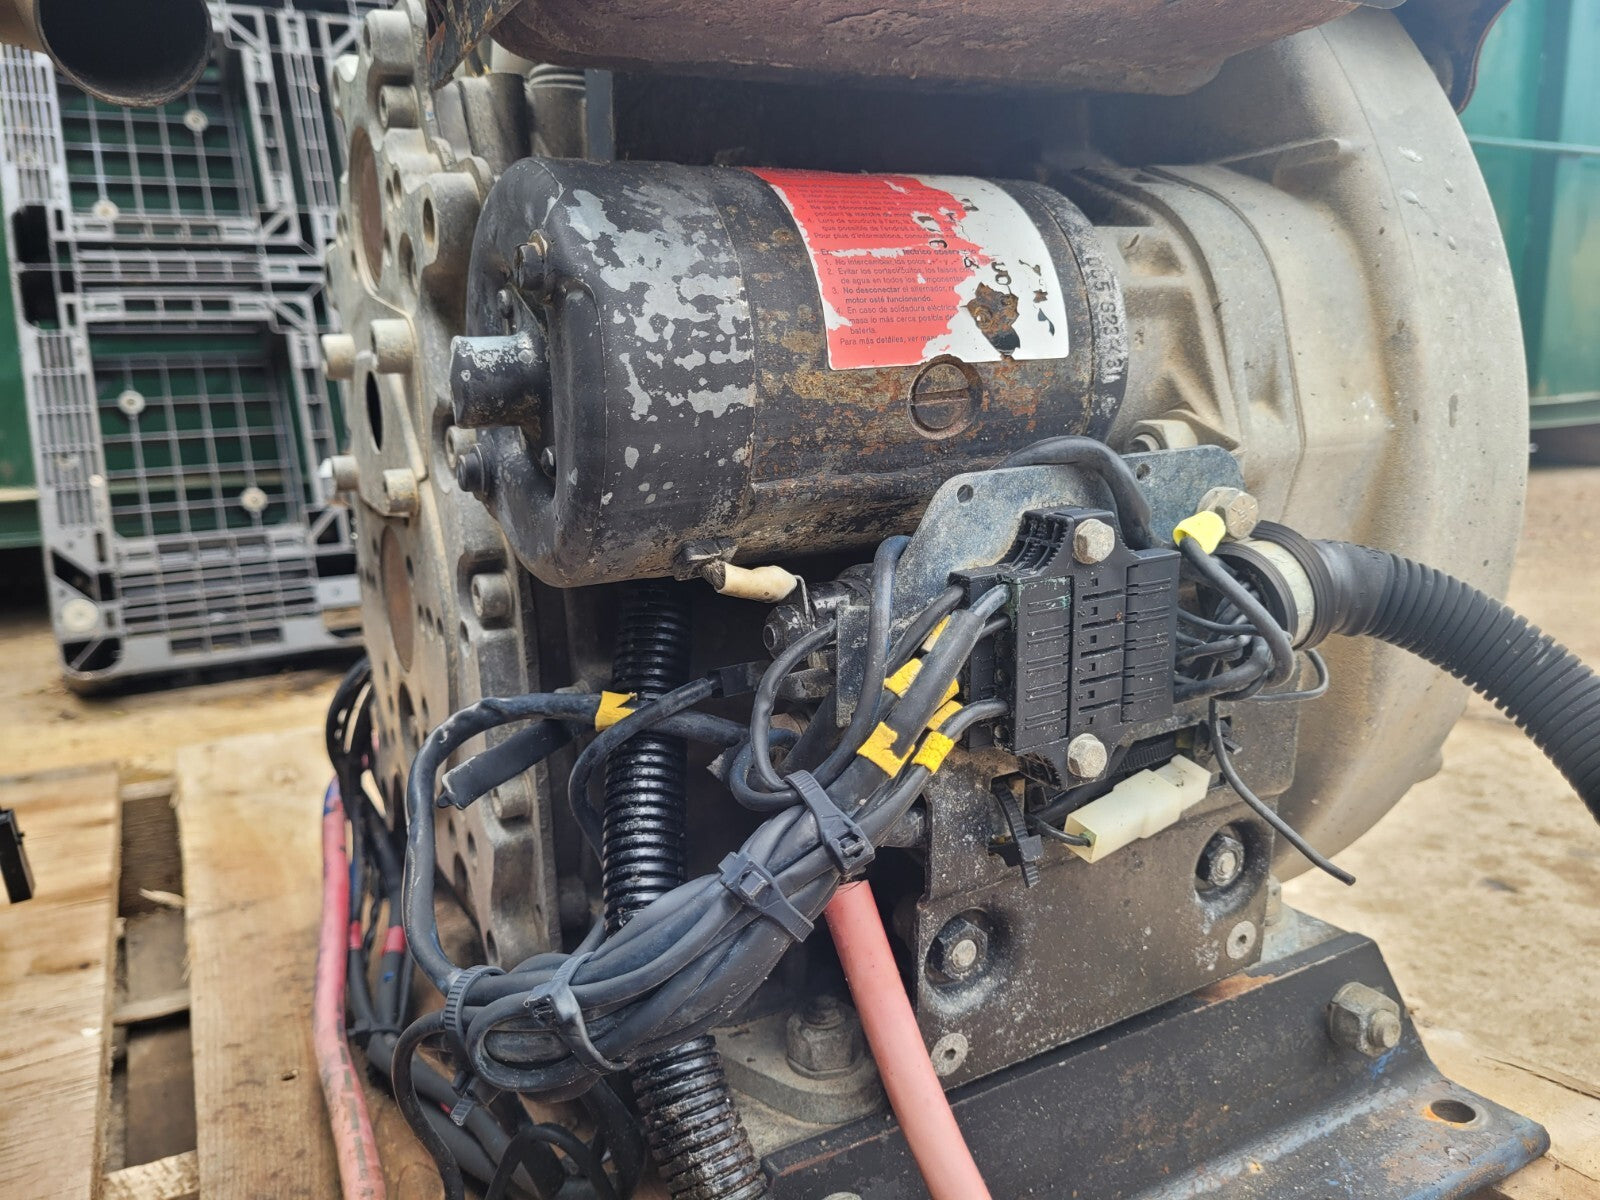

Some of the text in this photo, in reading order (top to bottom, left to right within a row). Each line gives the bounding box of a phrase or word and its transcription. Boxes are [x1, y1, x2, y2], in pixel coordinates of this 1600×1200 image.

[886, 296, 934, 304] funcionando.
[880, 316, 894, 324] más
[918, 314, 944, 323] posible
[840, 338, 858, 346] Para
[858, 337, 874, 345] más
